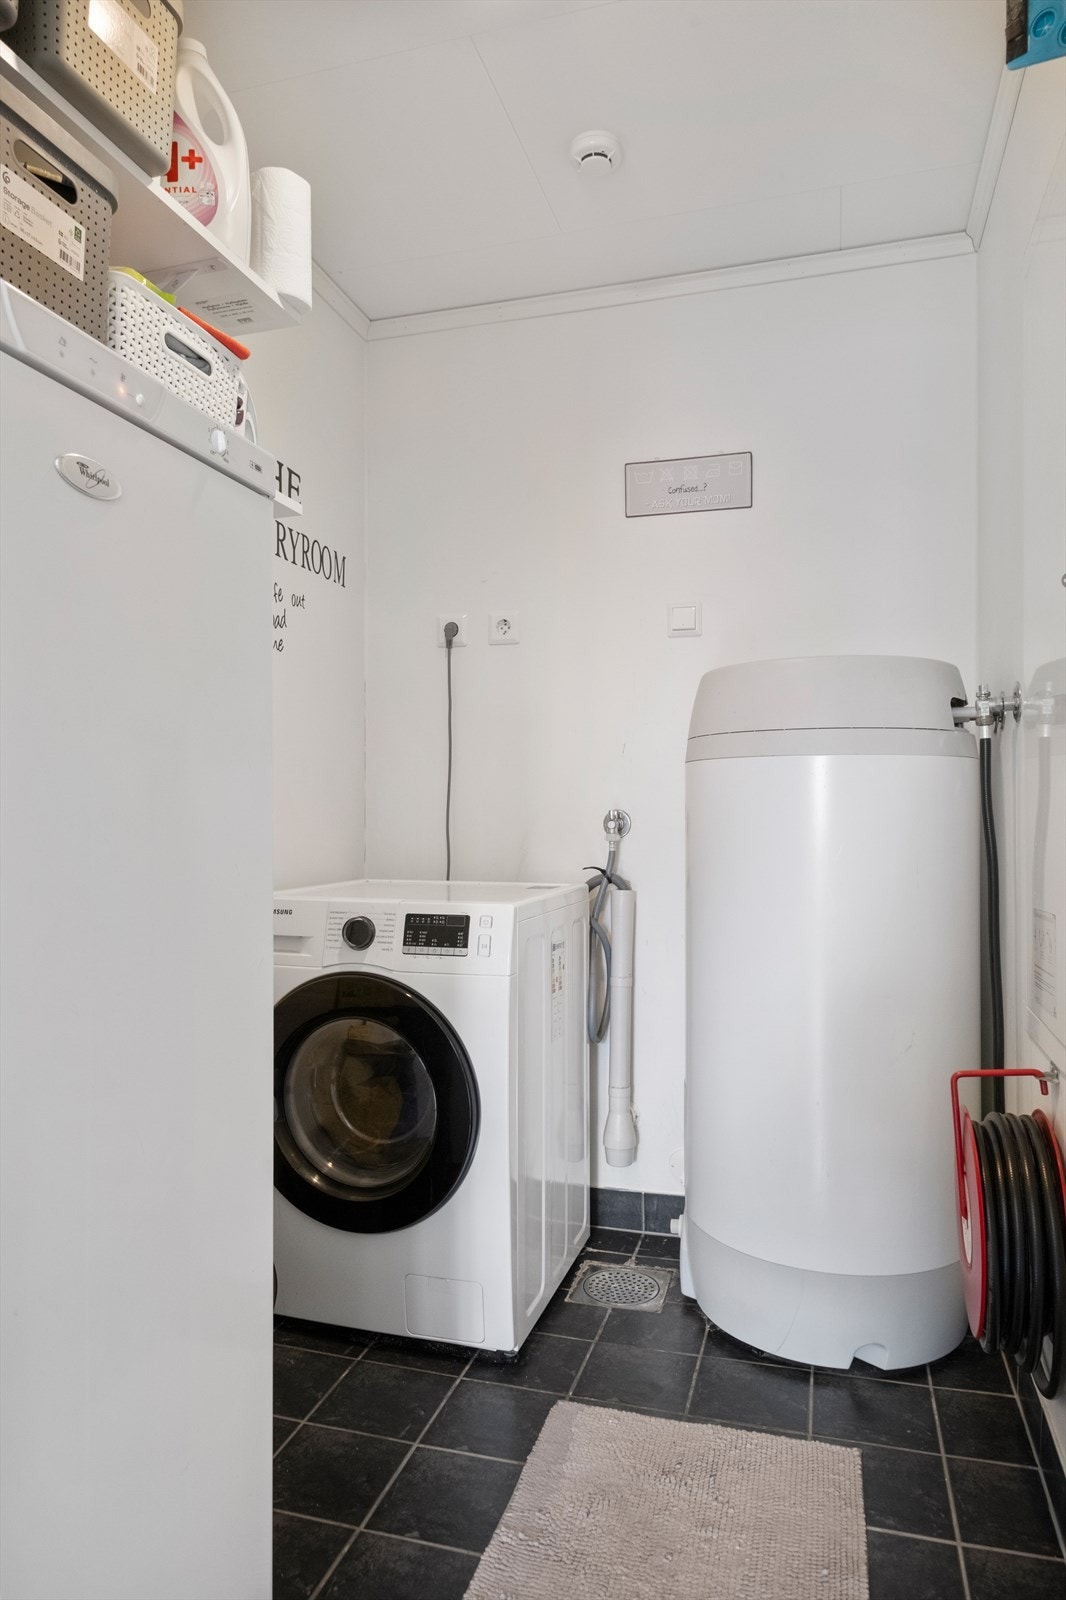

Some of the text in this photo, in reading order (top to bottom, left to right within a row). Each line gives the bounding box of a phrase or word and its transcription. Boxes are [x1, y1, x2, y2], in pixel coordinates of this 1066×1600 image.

[3, 186, 30, 211] Storage
[78, 466, 110, 488] Whirlpool
[675, 496, 702, 507] YOUR
[291, 593, 306, 609] out
